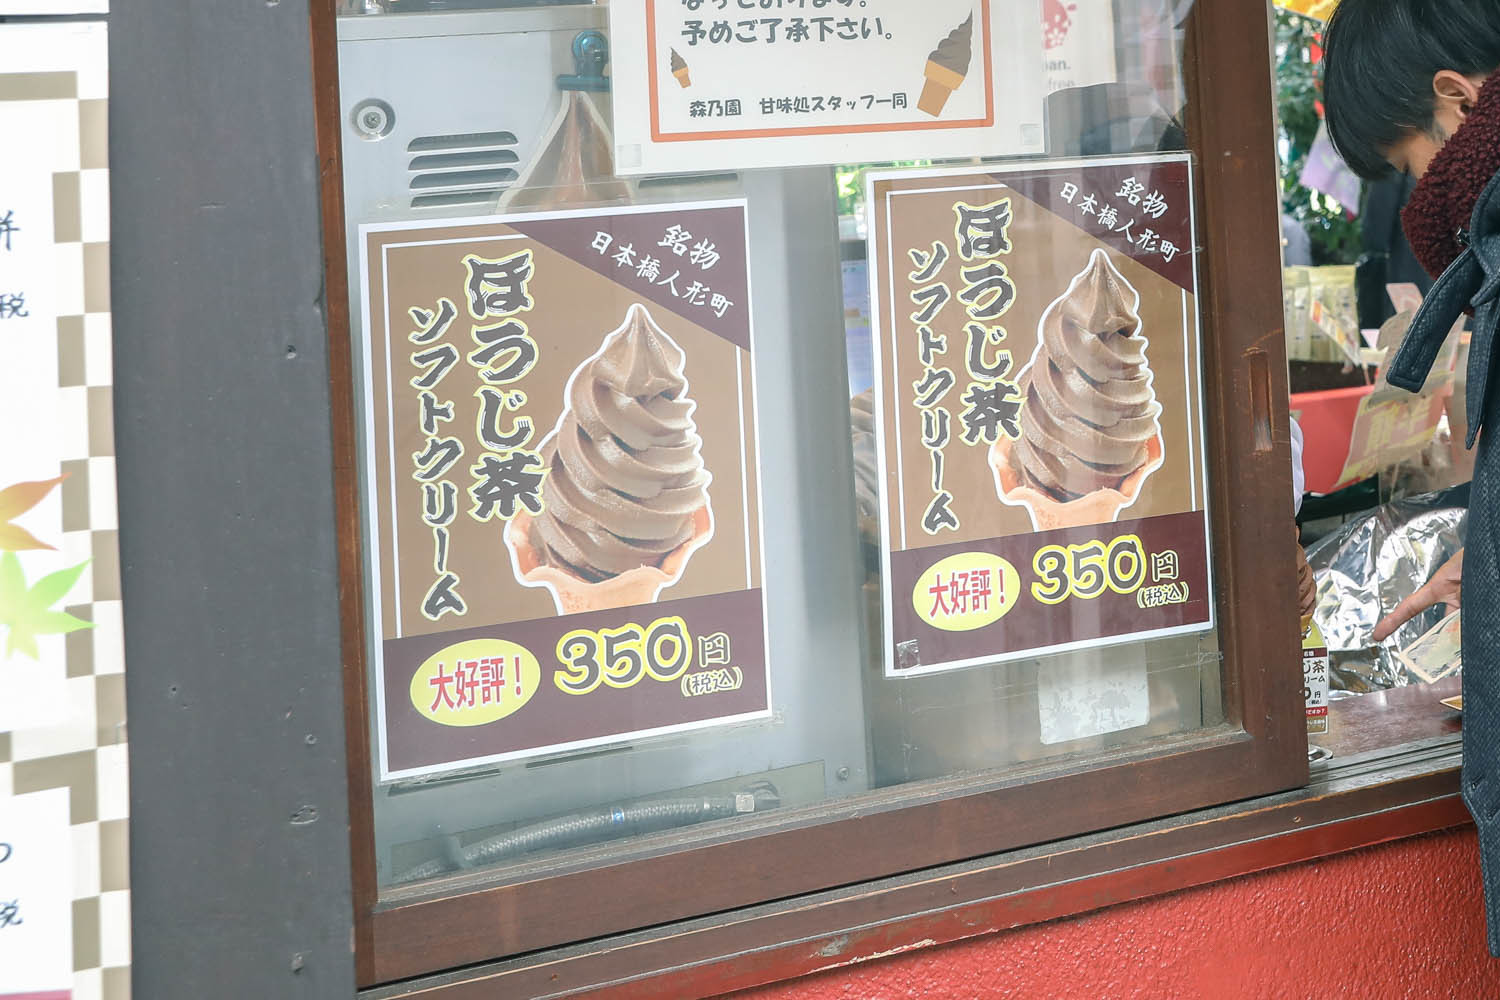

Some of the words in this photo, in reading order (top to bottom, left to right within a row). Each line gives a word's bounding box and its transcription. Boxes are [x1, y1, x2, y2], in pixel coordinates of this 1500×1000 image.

[680, 16, 894, 47] 予めご了承下さい。
[689, 98, 742, 119] 森乃園
[758, 92, 908, 115] 甘味処スタッフ一同
[1060, 181, 1181, 263] 日本橋人形町
[1116, 176, 1169, 220] 銘物
[591, 230, 735, 318] 日本橋人形町
[656, 223, 721, 273] 銘物
[957, 200, 1021, 444] ほうじ茶
[466, 252, 545, 519] ほうじ茶
[910, 243, 957, 534] ソフトクリーム
[409, 299, 463, 619] ソフトクリーム
[928, 569, 1007, 619] 大好評！
[430, 656, 525, 715] 大好評！
